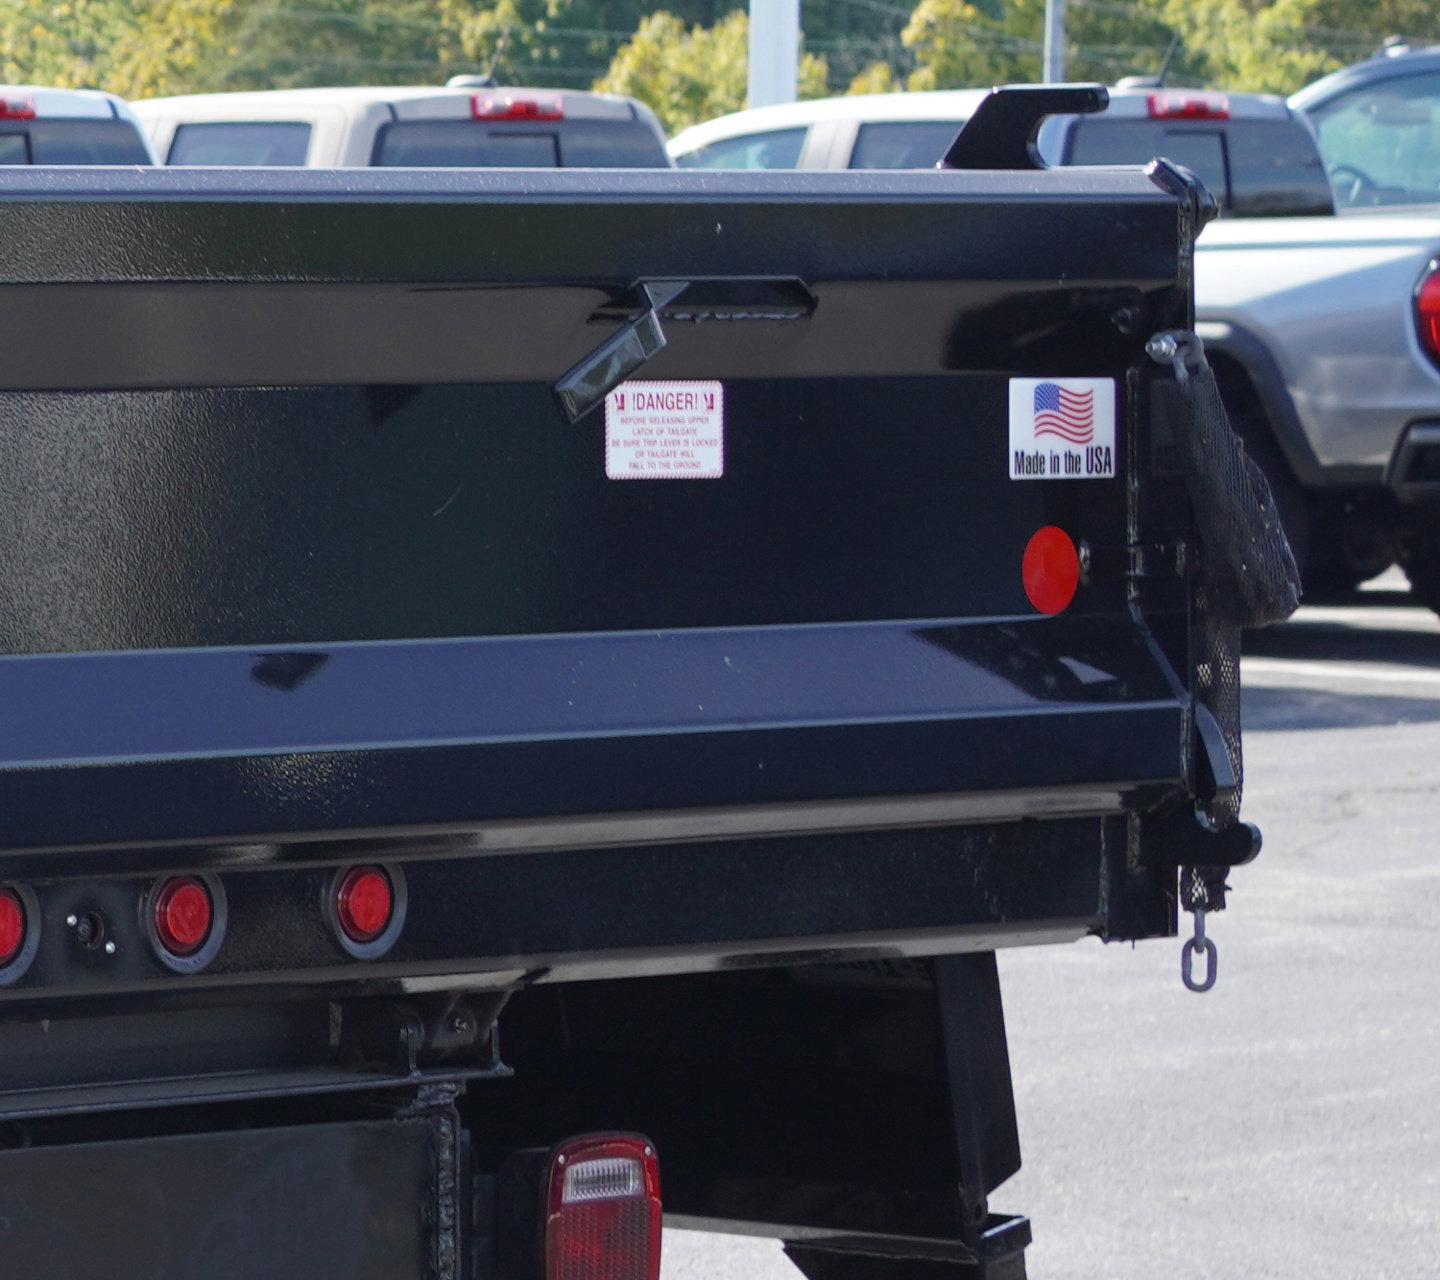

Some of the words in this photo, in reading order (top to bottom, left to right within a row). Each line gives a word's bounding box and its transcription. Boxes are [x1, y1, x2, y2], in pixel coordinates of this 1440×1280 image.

[632, 428, 654, 436] LATCH
[1014, 450, 1045, 475] Made
[1050, 450, 1060, 474] in
[1064, 449, 1081, 474] the
[1085, 446, 1112, 474] USA
